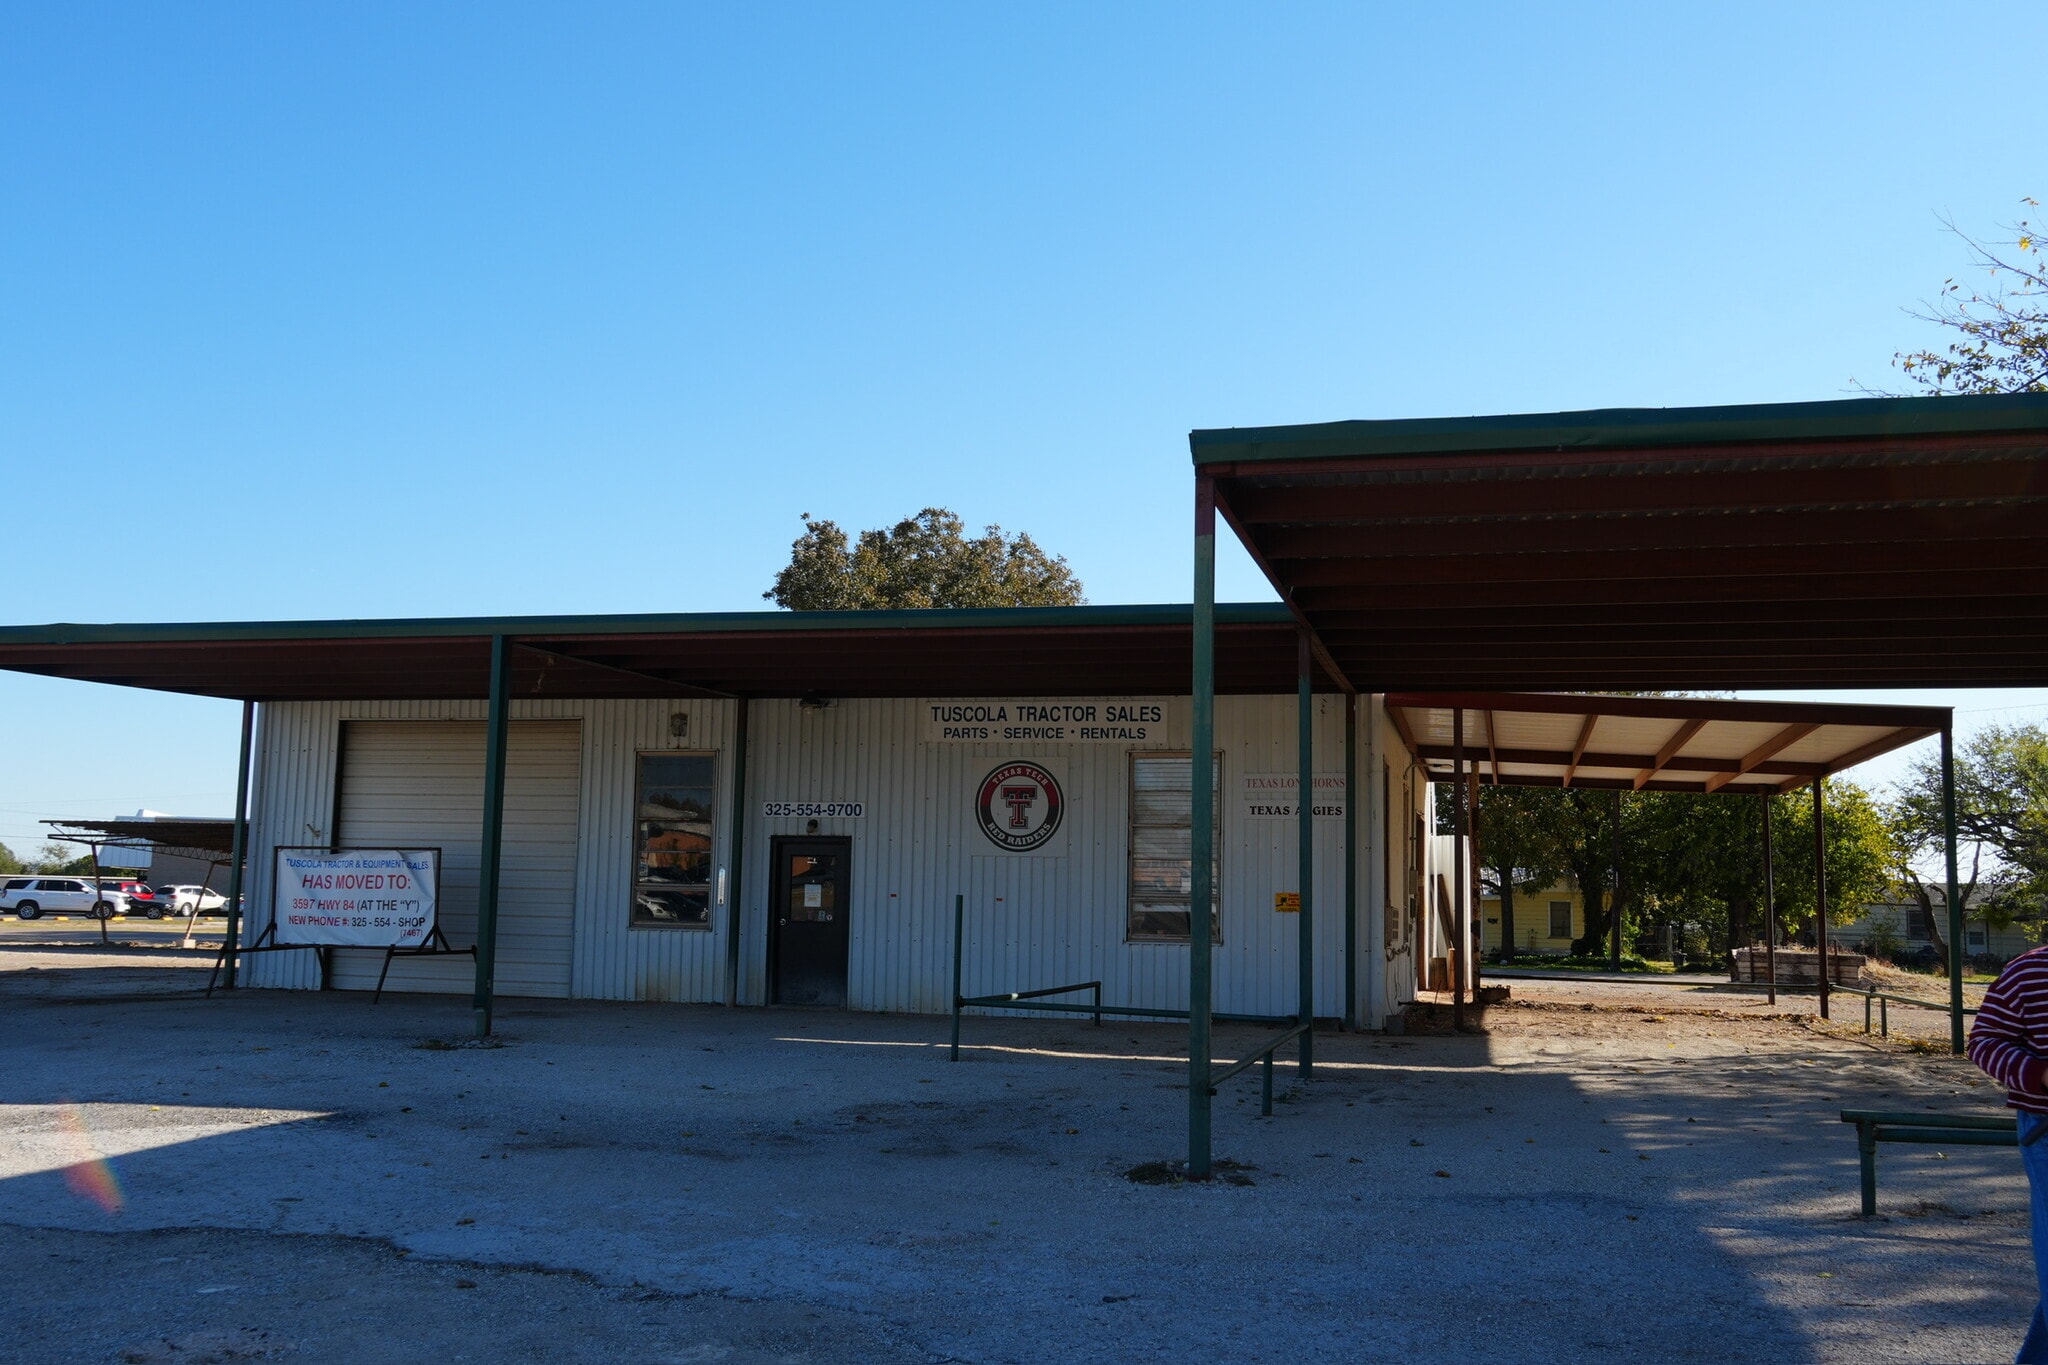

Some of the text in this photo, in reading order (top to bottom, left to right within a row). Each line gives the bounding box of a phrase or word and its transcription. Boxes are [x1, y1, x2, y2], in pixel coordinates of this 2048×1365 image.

[931, 705, 1162, 722] TUSCOLA TRACTOR SALES
[943, 727, 1147, 739] PARTS SERVICE RENTALS
[991, 767, 1049, 786] TEXAS TECH
[1245, 777, 1345, 789] TEXAS LONHORNS
[765, 803, 862, 817] 325-554-9700
[1249, 805, 1343, 816] TEXAS AGIES
[987, 822, 1051, 845] RED RAIDERS
[286, 858, 429, 870] TUSCOLA TRACTOR & EQUIPMENT SALES
[302, 874, 411, 890] HAS MOVED TO:
[292, 898, 315, 910] 3597
[317, 899, 341, 910] HWY
[342, 899, 355, 910] 84
[356, 899, 373, 913] (AT
[376, 899, 397, 911] THE
[288, 915, 307, 925] NEW
[308, 915, 340, 926] PHONE
[351, 917, 367, 927] 325
[374, 917, 391, 927] 554
[398, 917, 426, 927] SHOP
[400, 928, 423, 938] (7467)
